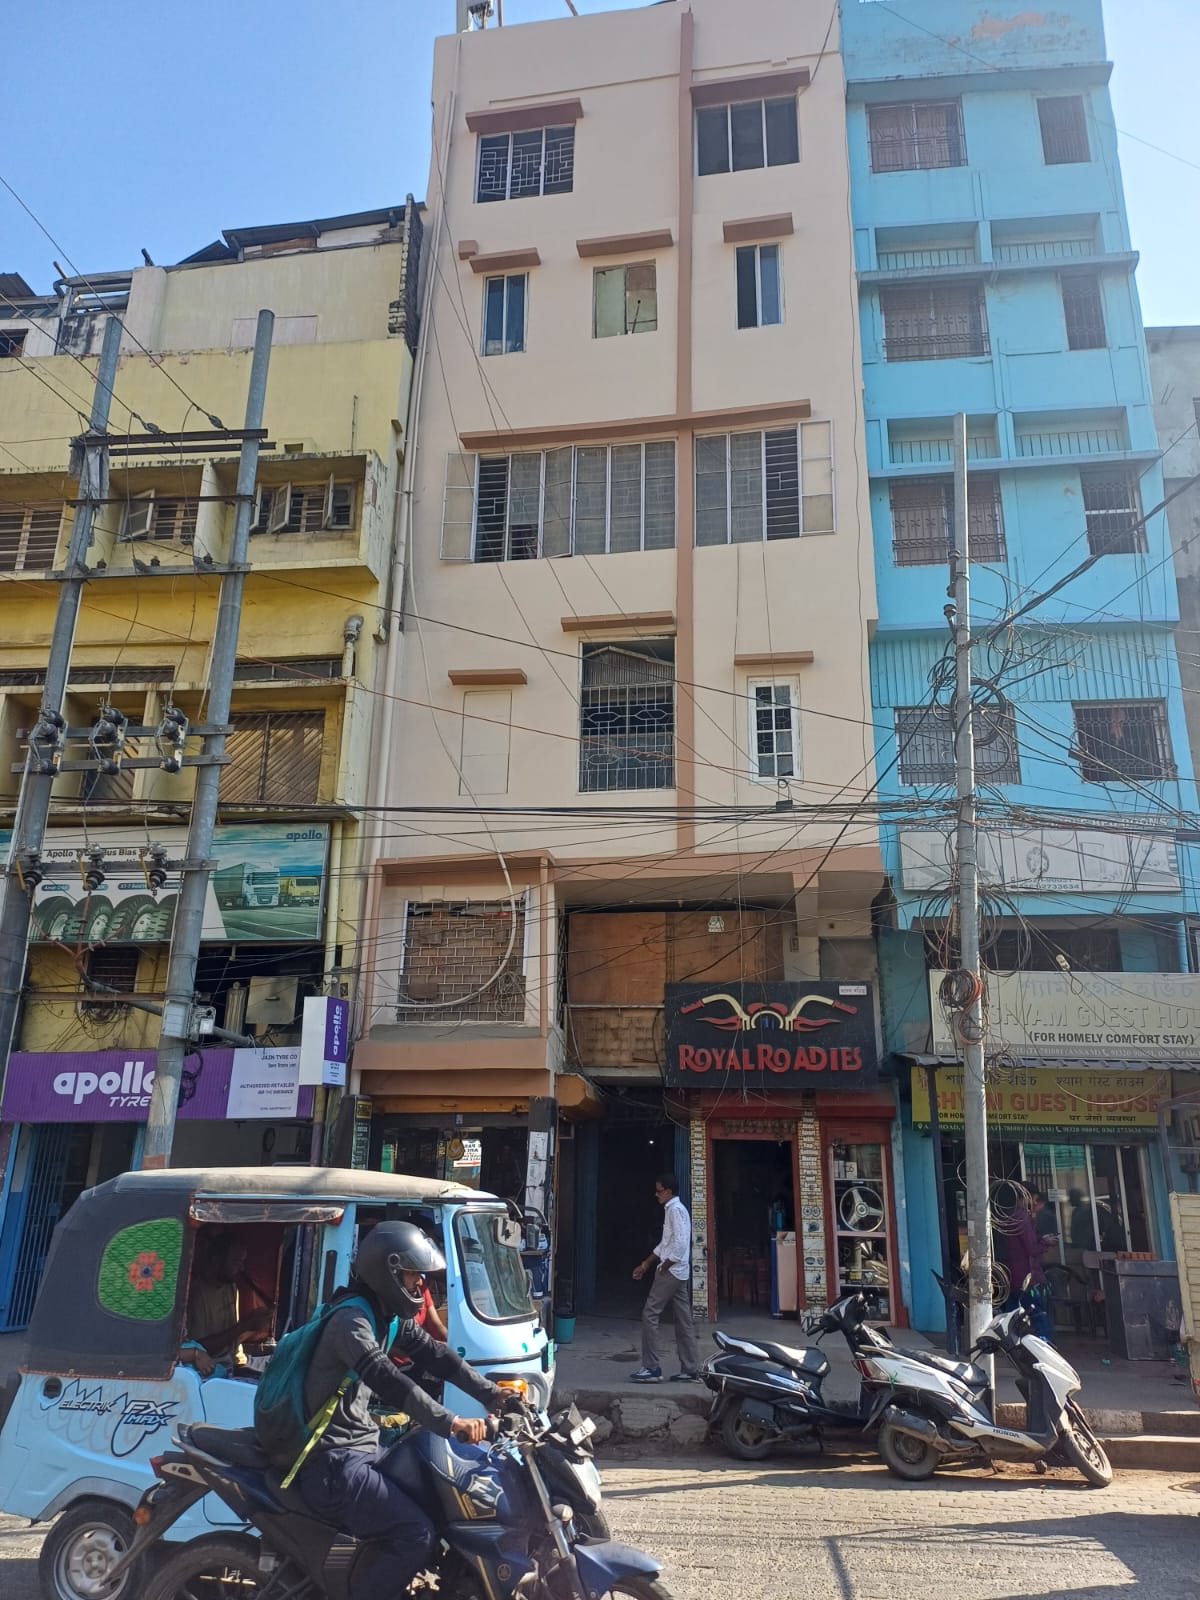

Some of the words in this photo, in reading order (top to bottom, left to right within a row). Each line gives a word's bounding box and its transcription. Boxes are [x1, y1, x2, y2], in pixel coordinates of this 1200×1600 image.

[287, 830, 323, 842] apollo
[46, 849, 74, 859] Apollo
[1077, 1006, 1149, 1029] GUEST
[332, 1004, 341, 1056] apollo
[1029, 1031, 1055, 1043] (FOR
[1058, 1032, 1103, 1043] HOMELY
[1105, 1033, 1160, 1045] COMFORT
[1162, 1034, 1195, 1045] STAY)
[678, 1045, 755, 1073] ROYAL
[757, 1044, 863, 1073] ROADIES
[53, 1061, 156, 1105] apollo
[109, 1096, 152, 1107] TYRE
[1010, 1092, 1080, 1112] GUEST
[1086, 1093, 1160, 1113] HOUSE
[59, 1400, 115, 1413] ELECTRIK
[121, 1400, 180, 1415] FX
[123, 1415, 176, 1426] MAX
